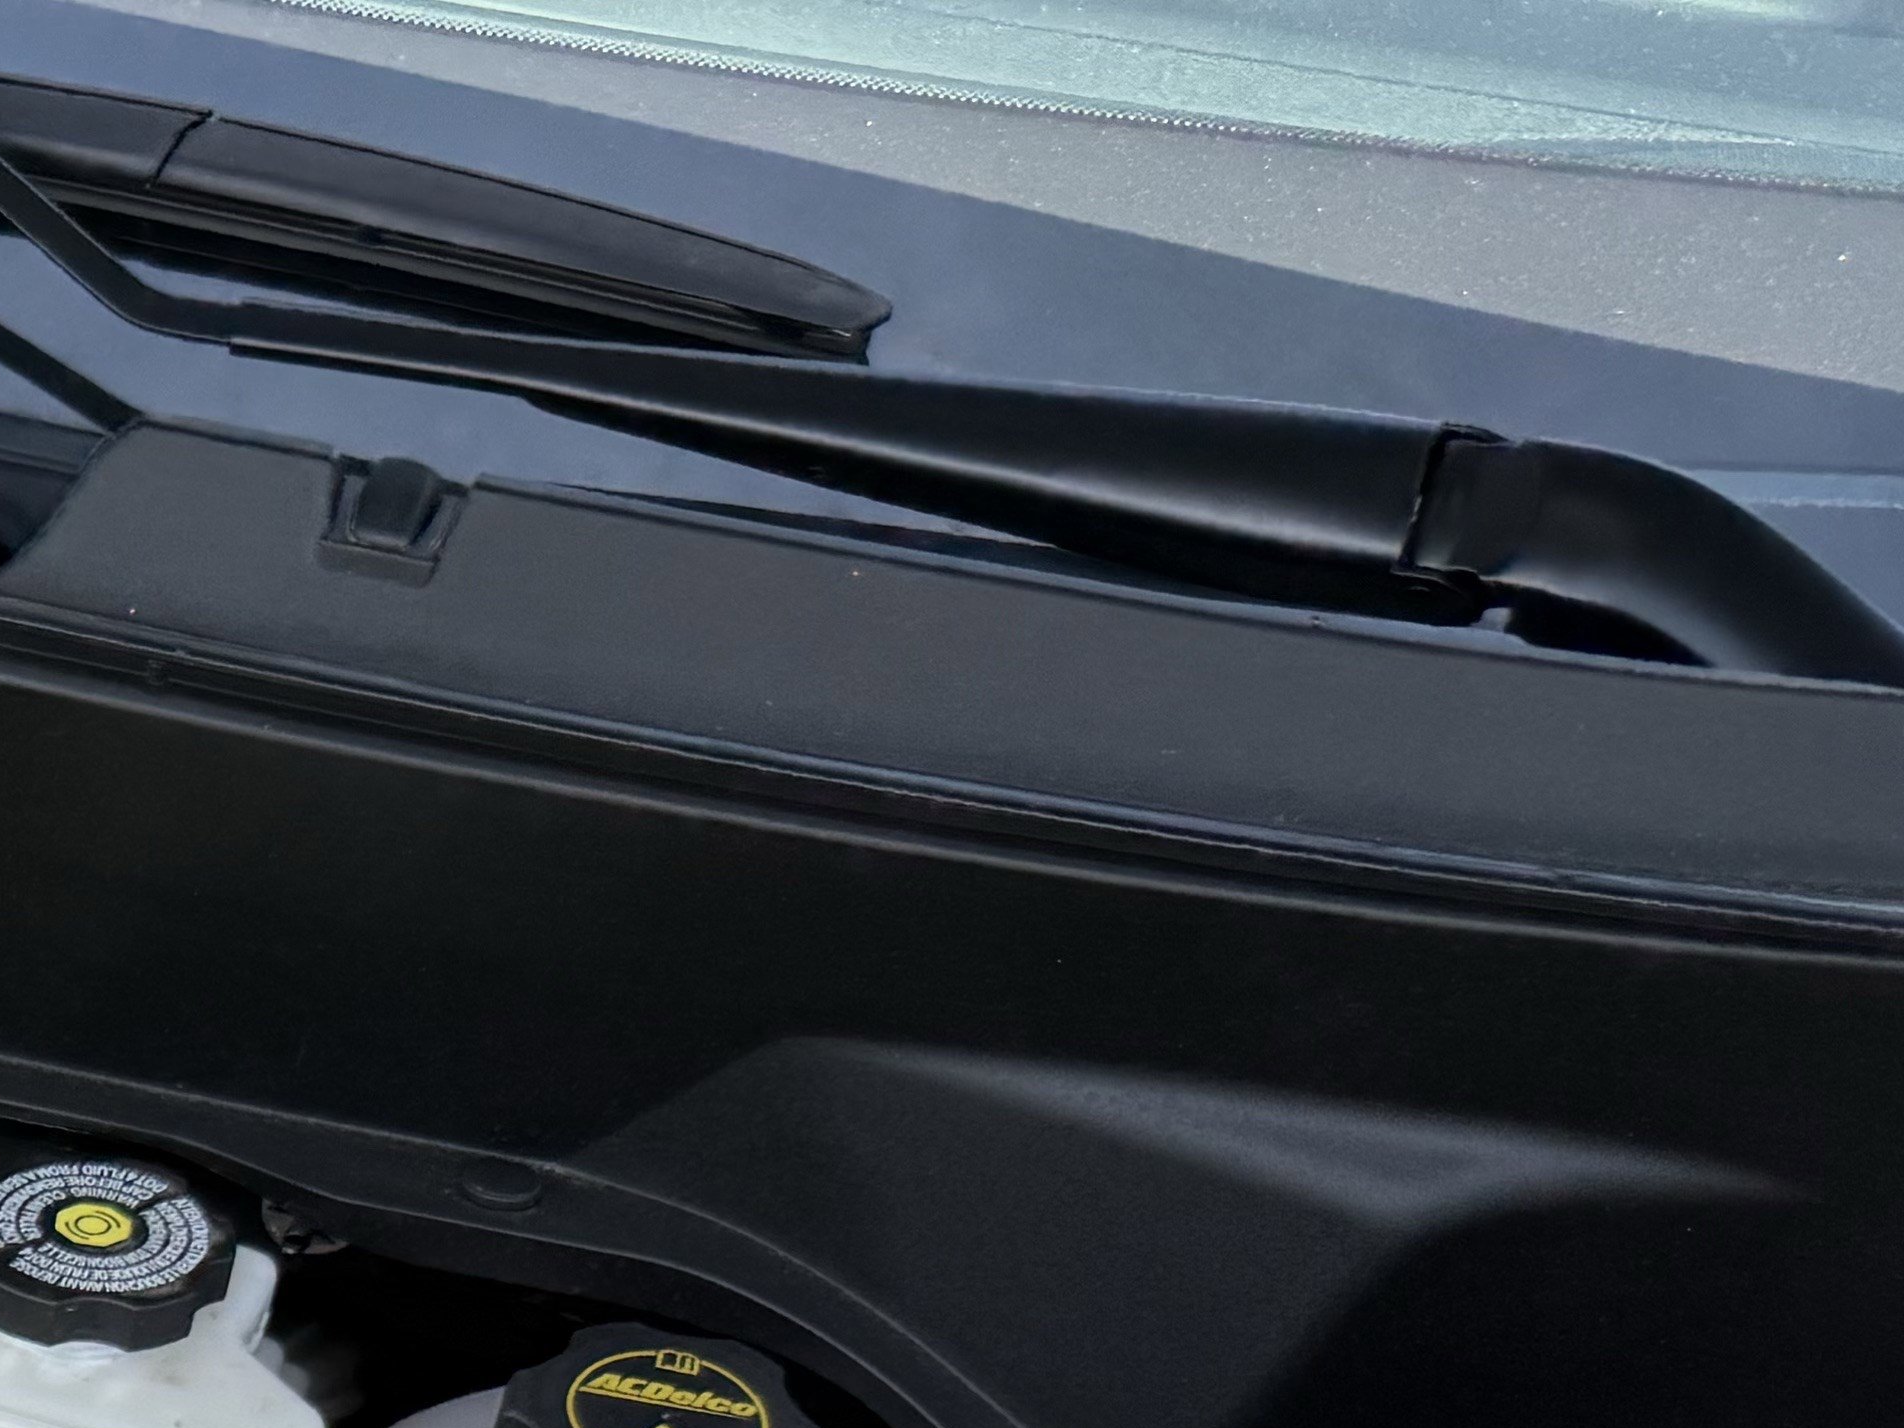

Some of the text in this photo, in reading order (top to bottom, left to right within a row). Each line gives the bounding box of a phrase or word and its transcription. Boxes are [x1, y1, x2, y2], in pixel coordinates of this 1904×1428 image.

[32, 1161, 80, 1181] FROM
[81, 1163, 129, 1179] FLUID
[62, 1173, 127, 1190] BEFORE
[120, 1181, 157, 1201] CAP
[133, 1172, 172, 1193] DOT
[55, 1276, 104, 1291] AVANT
[586, 1372, 759, 1418] ACDelco
